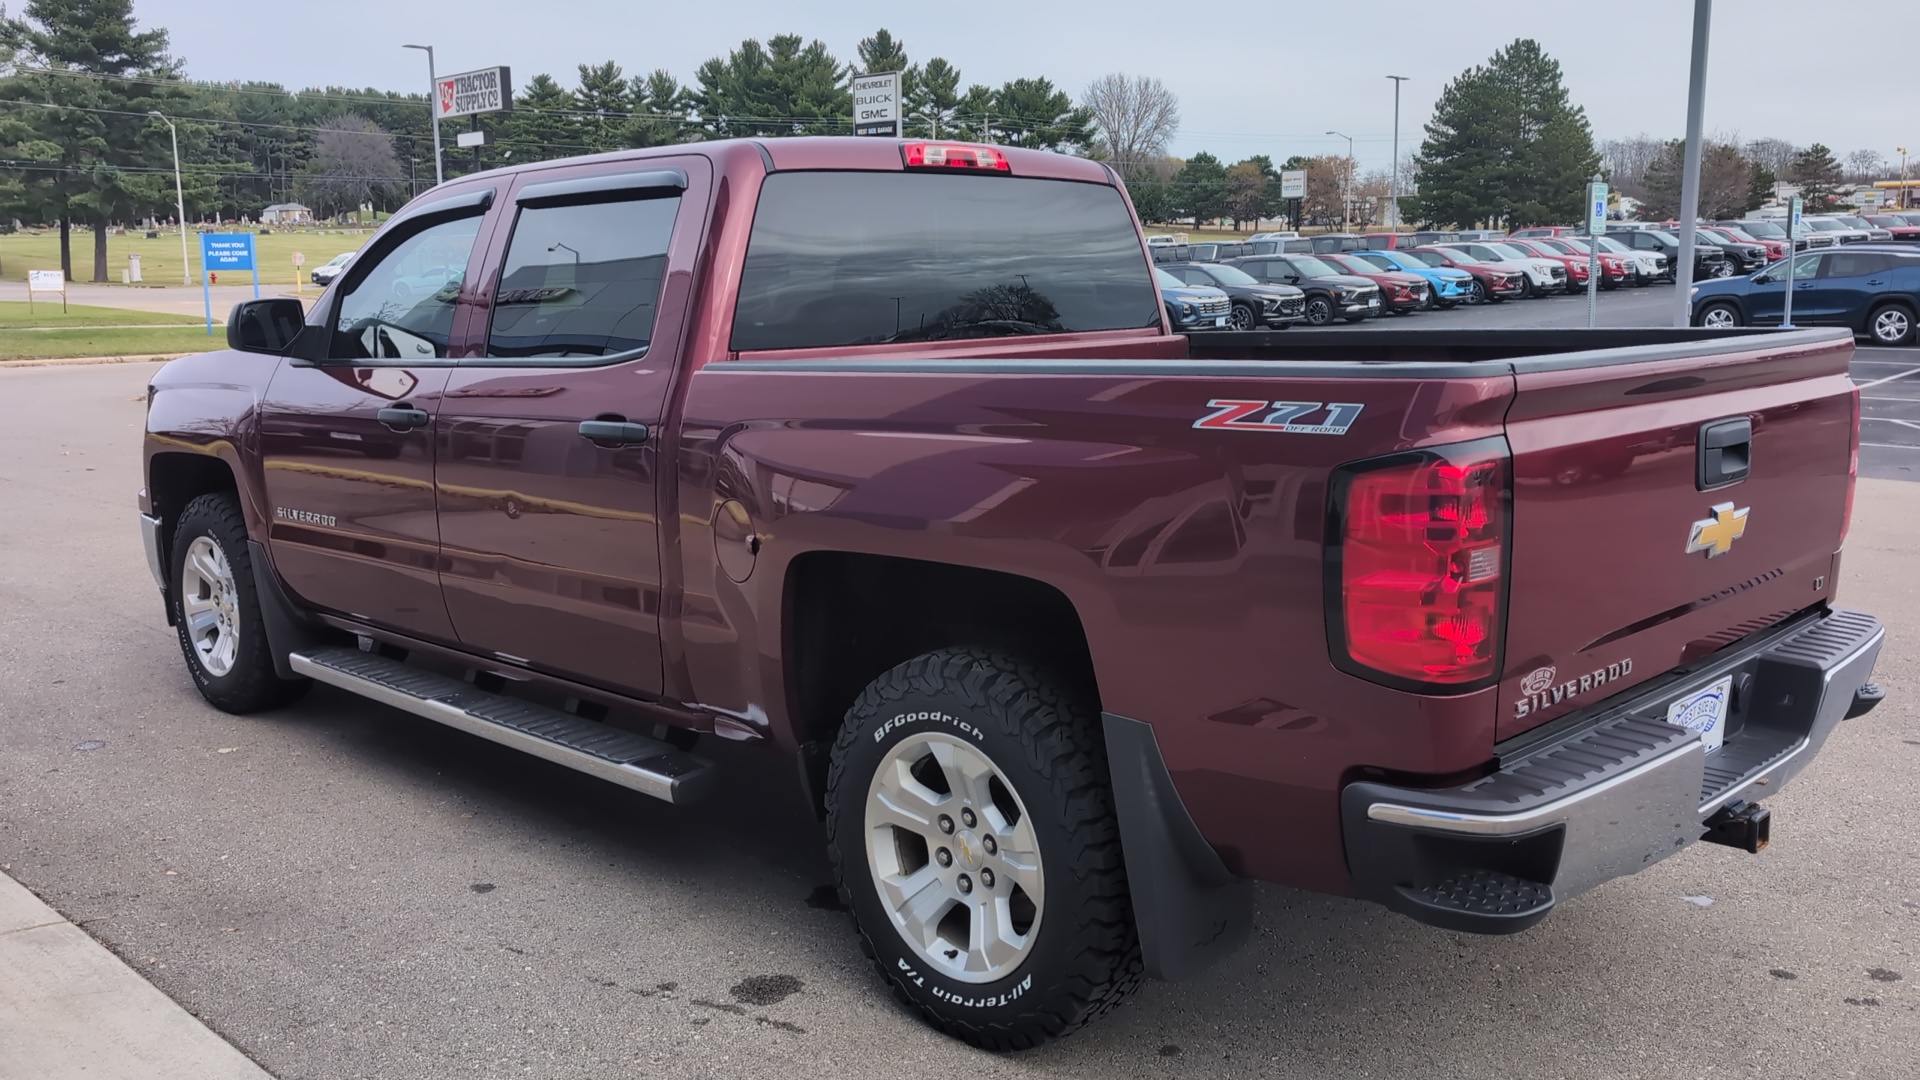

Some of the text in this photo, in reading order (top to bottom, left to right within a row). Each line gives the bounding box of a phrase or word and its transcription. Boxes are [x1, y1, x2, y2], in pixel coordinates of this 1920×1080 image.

[455, 72, 497, 94] TRACTOR
[856, 80, 892, 90] CHEVROLET
[456, 92, 487, 113] SUPPLY
[856, 94, 892, 105] BUICK
[861, 109, 888, 119] GMC
[1192, 398, 1365, 433] Z71
[1311, 426, 1345, 434] ROAD
[277, 506, 336, 527] SILVERADO
[1514, 658, 1633, 719] SILVERADO
[873, 711, 984, 743] BFGoodrich
[898, 957, 1032, 1007] All-Terrain T/A
